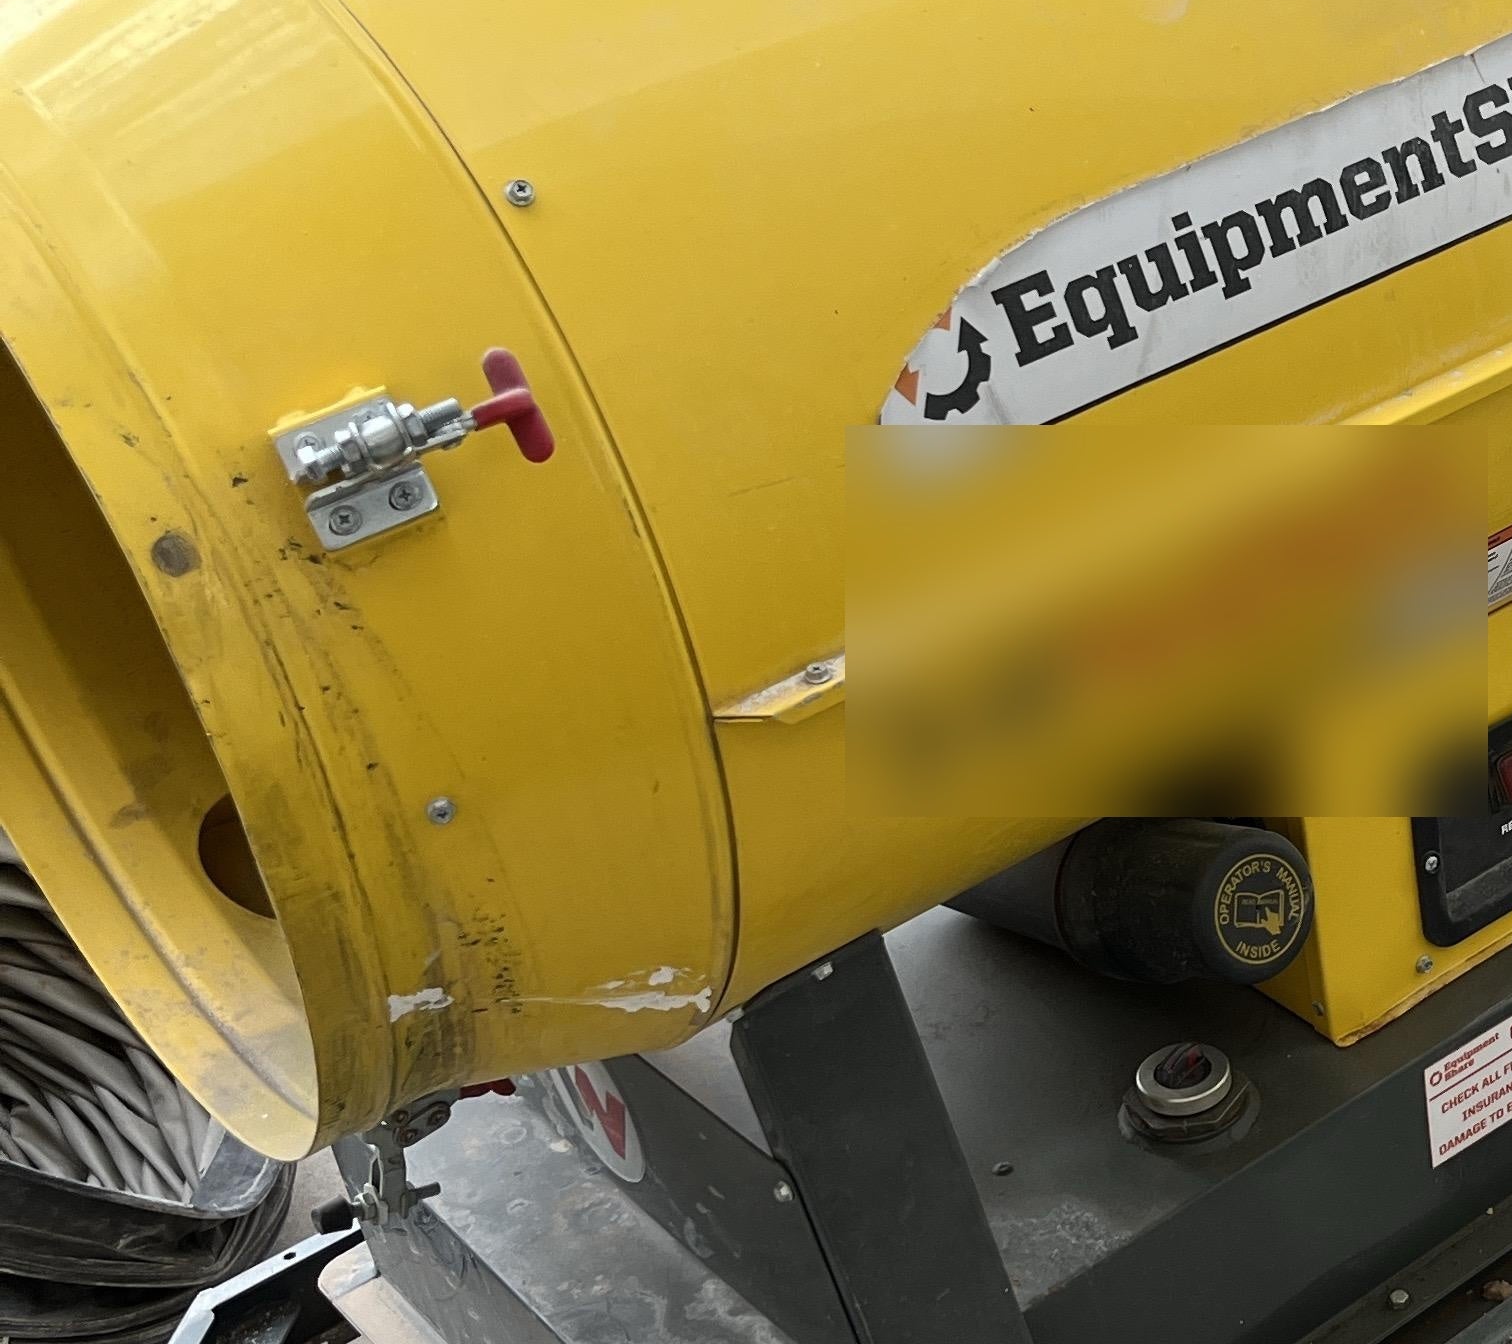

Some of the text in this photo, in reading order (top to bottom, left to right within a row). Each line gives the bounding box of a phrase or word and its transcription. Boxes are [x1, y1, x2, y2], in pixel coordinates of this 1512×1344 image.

[1219, 860, 1301, 925] OPERATOR'S MANUAL
[1236, 939, 1281, 958] INSIDE
[1444, 1032, 1500, 1071] Equipment
[1444, 1058, 1475, 1082] Share
[1441, 1083, 1479, 1114] CHECK
[1482, 1071, 1502, 1089] ALL
[1439, 1120, 1487, 1156] DAMAGE
[1489, 1108, 1504, 1123] TO
